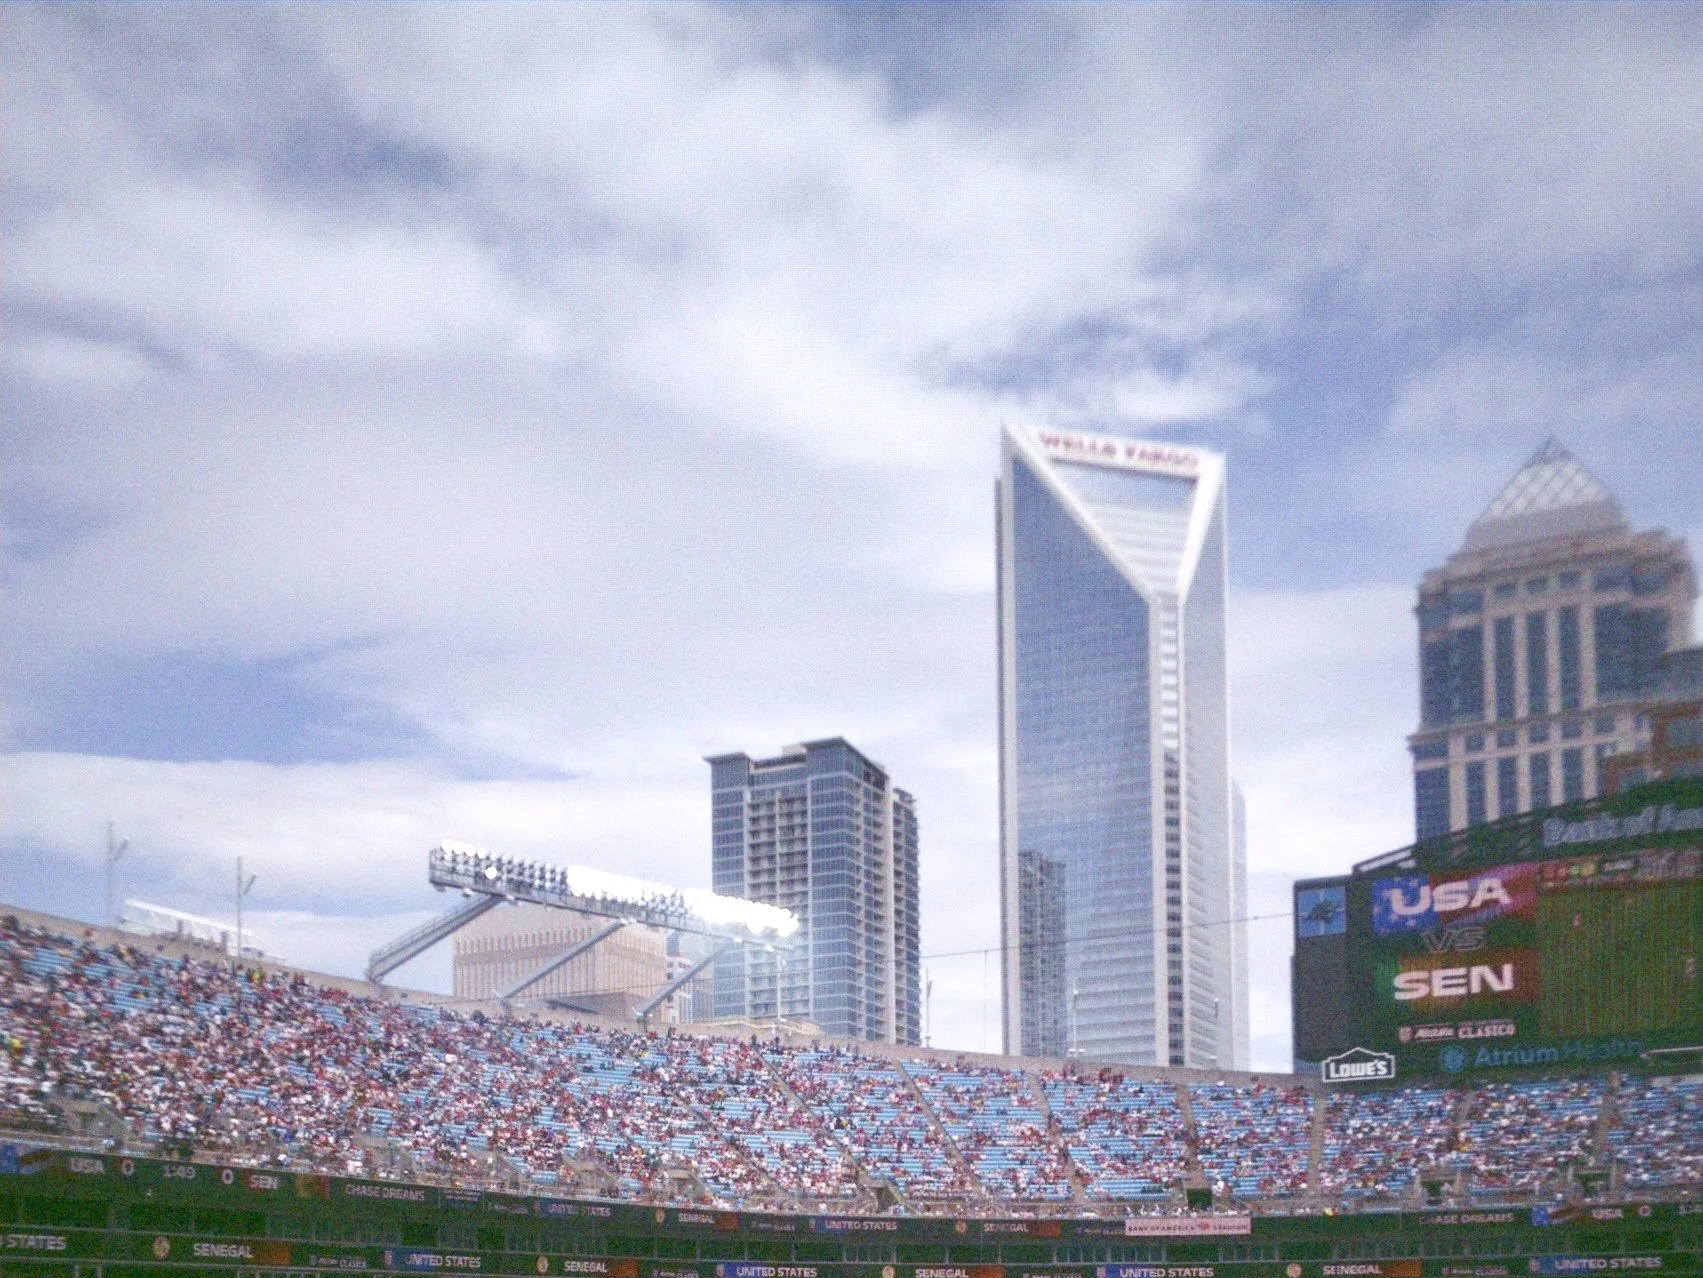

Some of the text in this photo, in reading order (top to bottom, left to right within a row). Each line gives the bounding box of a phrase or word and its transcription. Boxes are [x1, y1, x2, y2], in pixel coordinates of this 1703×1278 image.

[1390, 878, 1511, 915] USA
[1393, 963, 1514, 1000] SEN
[1329, 1059, 1388, 1078] LOWE'S
[69, 1157, 104, 1174] USA
[7, 1234, 67, 1251] STATES
[193, 1243, 254, 1258] SENEGAL
[406, 1253, 481, 1268] UNITED STATES
[564, 1261, 608, 1273] SENEGAL
[1555, 1257, 1663, 1270] UNITED STATES
[736, 1267, 818, 1278] UNITED STATES
[915, 1268, 969, 1278] SENEGAL
[1119, 1267, 1215, 1278] UNITED STATES
[1322, 1265, 1383, 1276] SENEGAL
